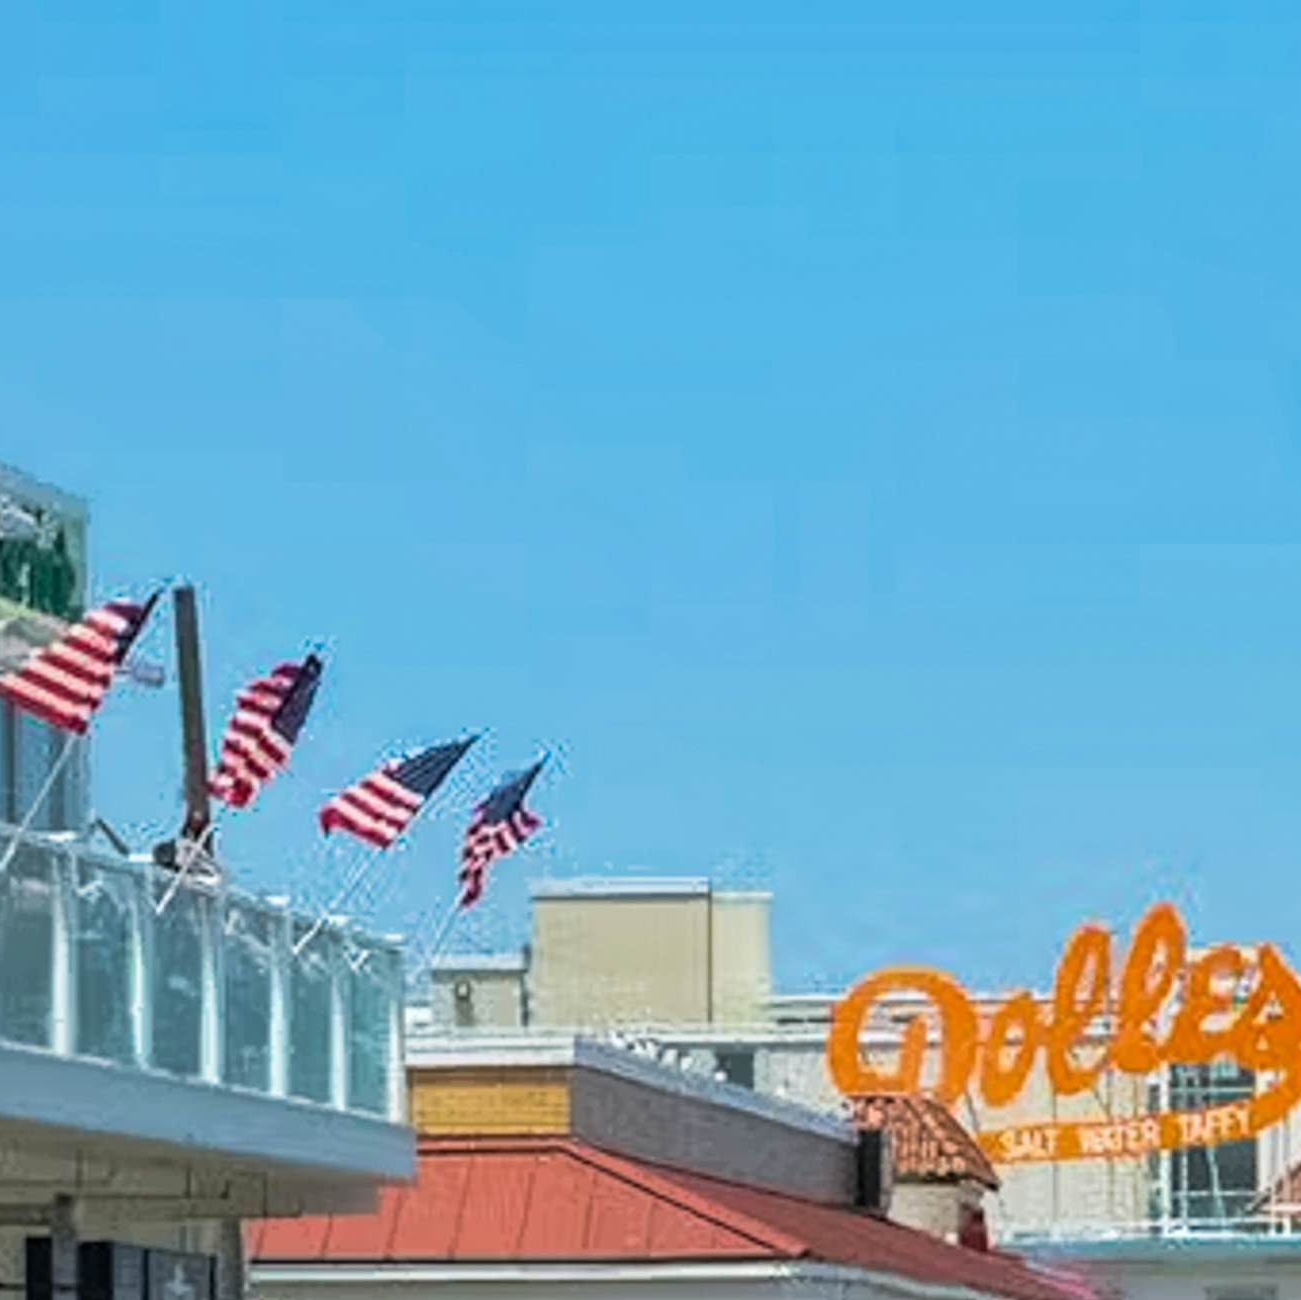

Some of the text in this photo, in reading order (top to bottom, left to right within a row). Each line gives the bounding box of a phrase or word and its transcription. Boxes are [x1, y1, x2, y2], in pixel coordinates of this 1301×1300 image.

[999, 1102, 1253, 1161] SALT WATER TAFFY
